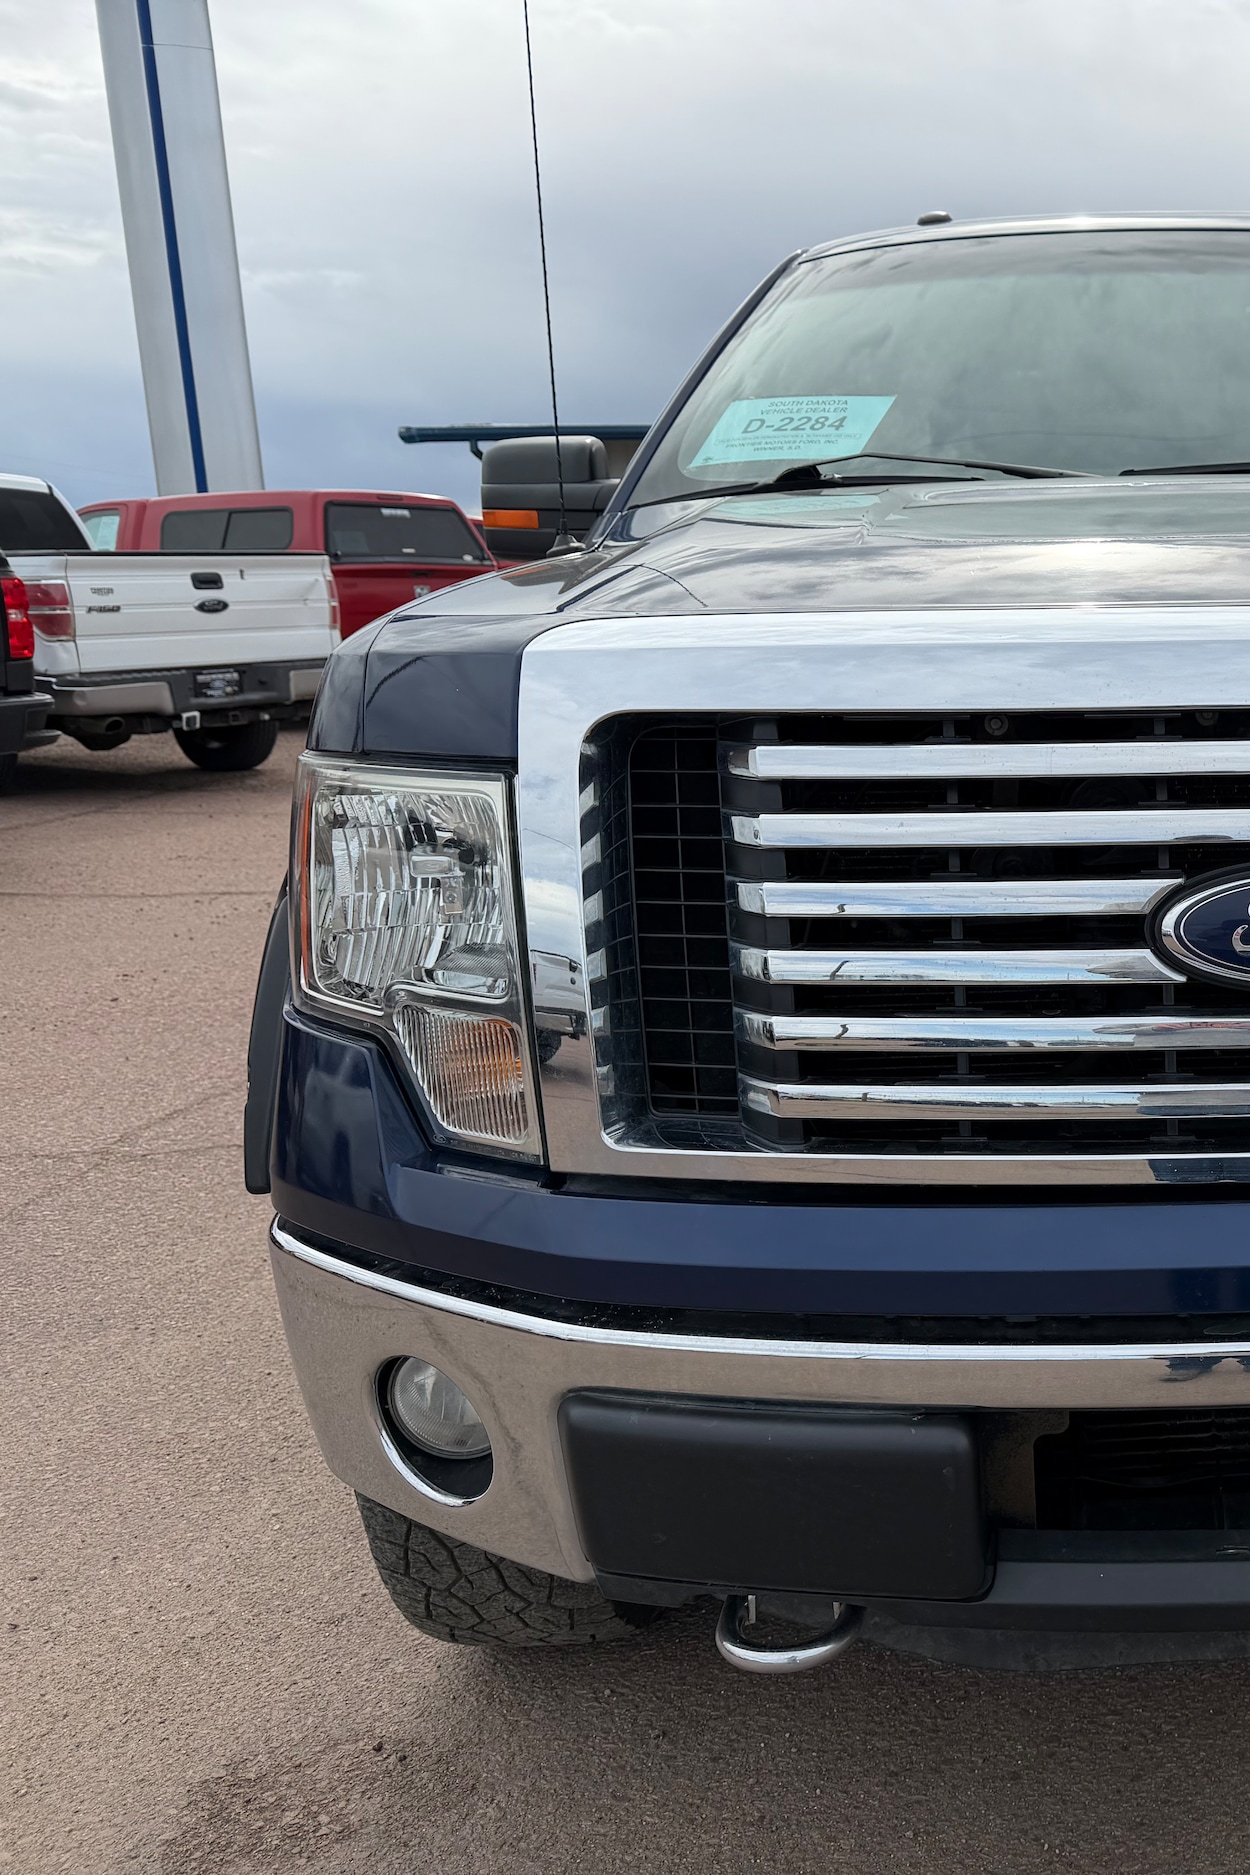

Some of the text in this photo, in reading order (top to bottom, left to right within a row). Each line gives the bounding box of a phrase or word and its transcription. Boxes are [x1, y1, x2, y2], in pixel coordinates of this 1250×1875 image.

[768, 400, 804, 408] SOUTH
[760, 407, 803, 415] VEHICLE
[741, 416, 848, 434] D-2284
